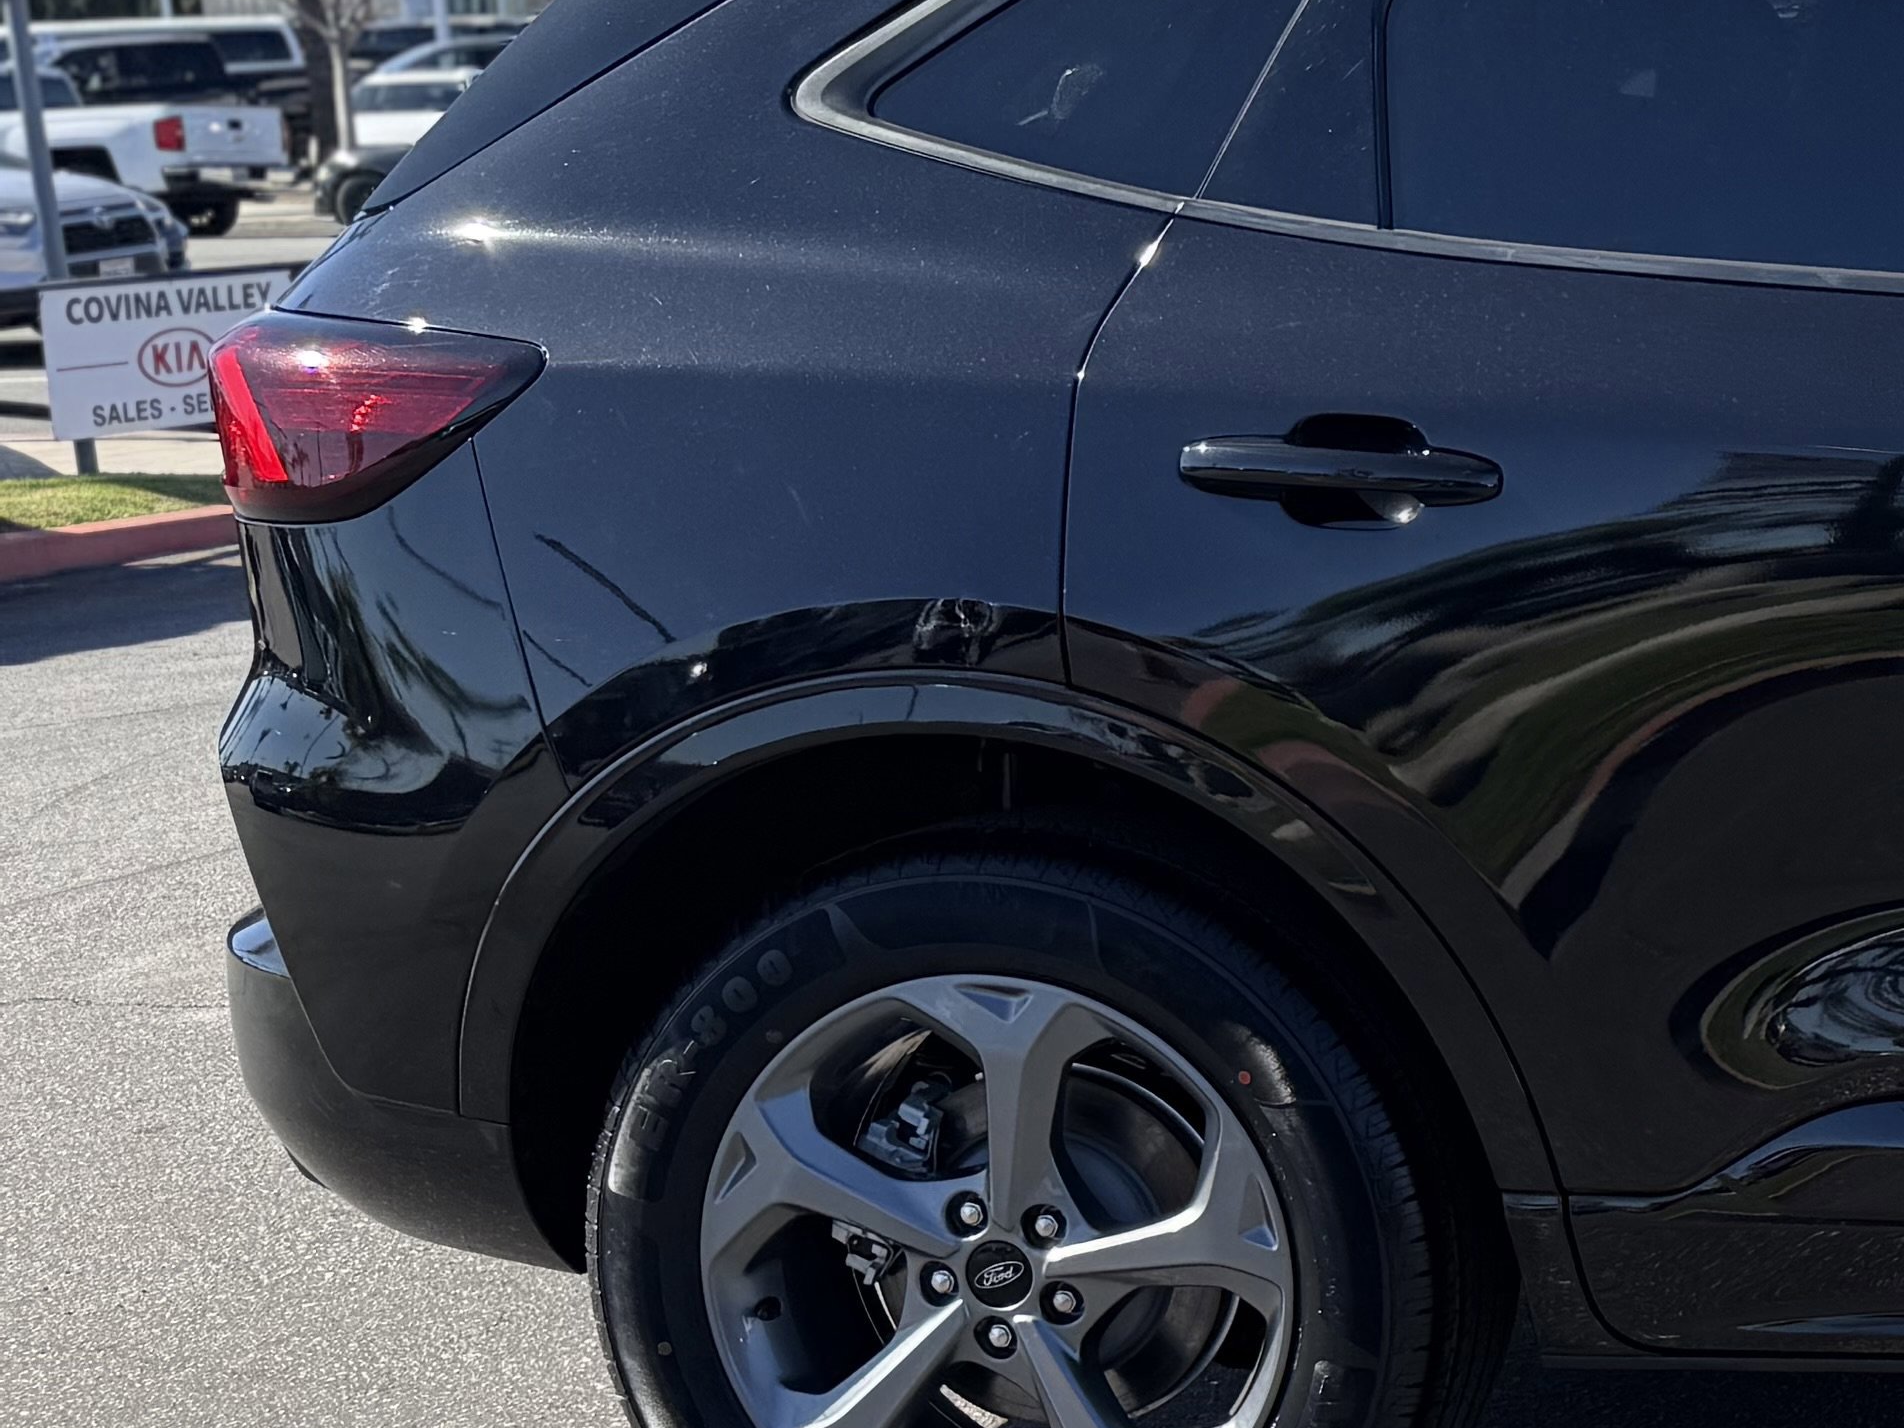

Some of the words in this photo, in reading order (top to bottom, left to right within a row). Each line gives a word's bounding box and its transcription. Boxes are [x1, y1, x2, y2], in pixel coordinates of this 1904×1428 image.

[66, 289, 173, 325] COVINA
[176, 280, 272, 314] VALLEY
[152, 339, 207, 376] KIA
[92, 398, 163, 427] SALES
[183, 392, 215, 416] SE
[983, 1265, 1014, 1287] Ford
